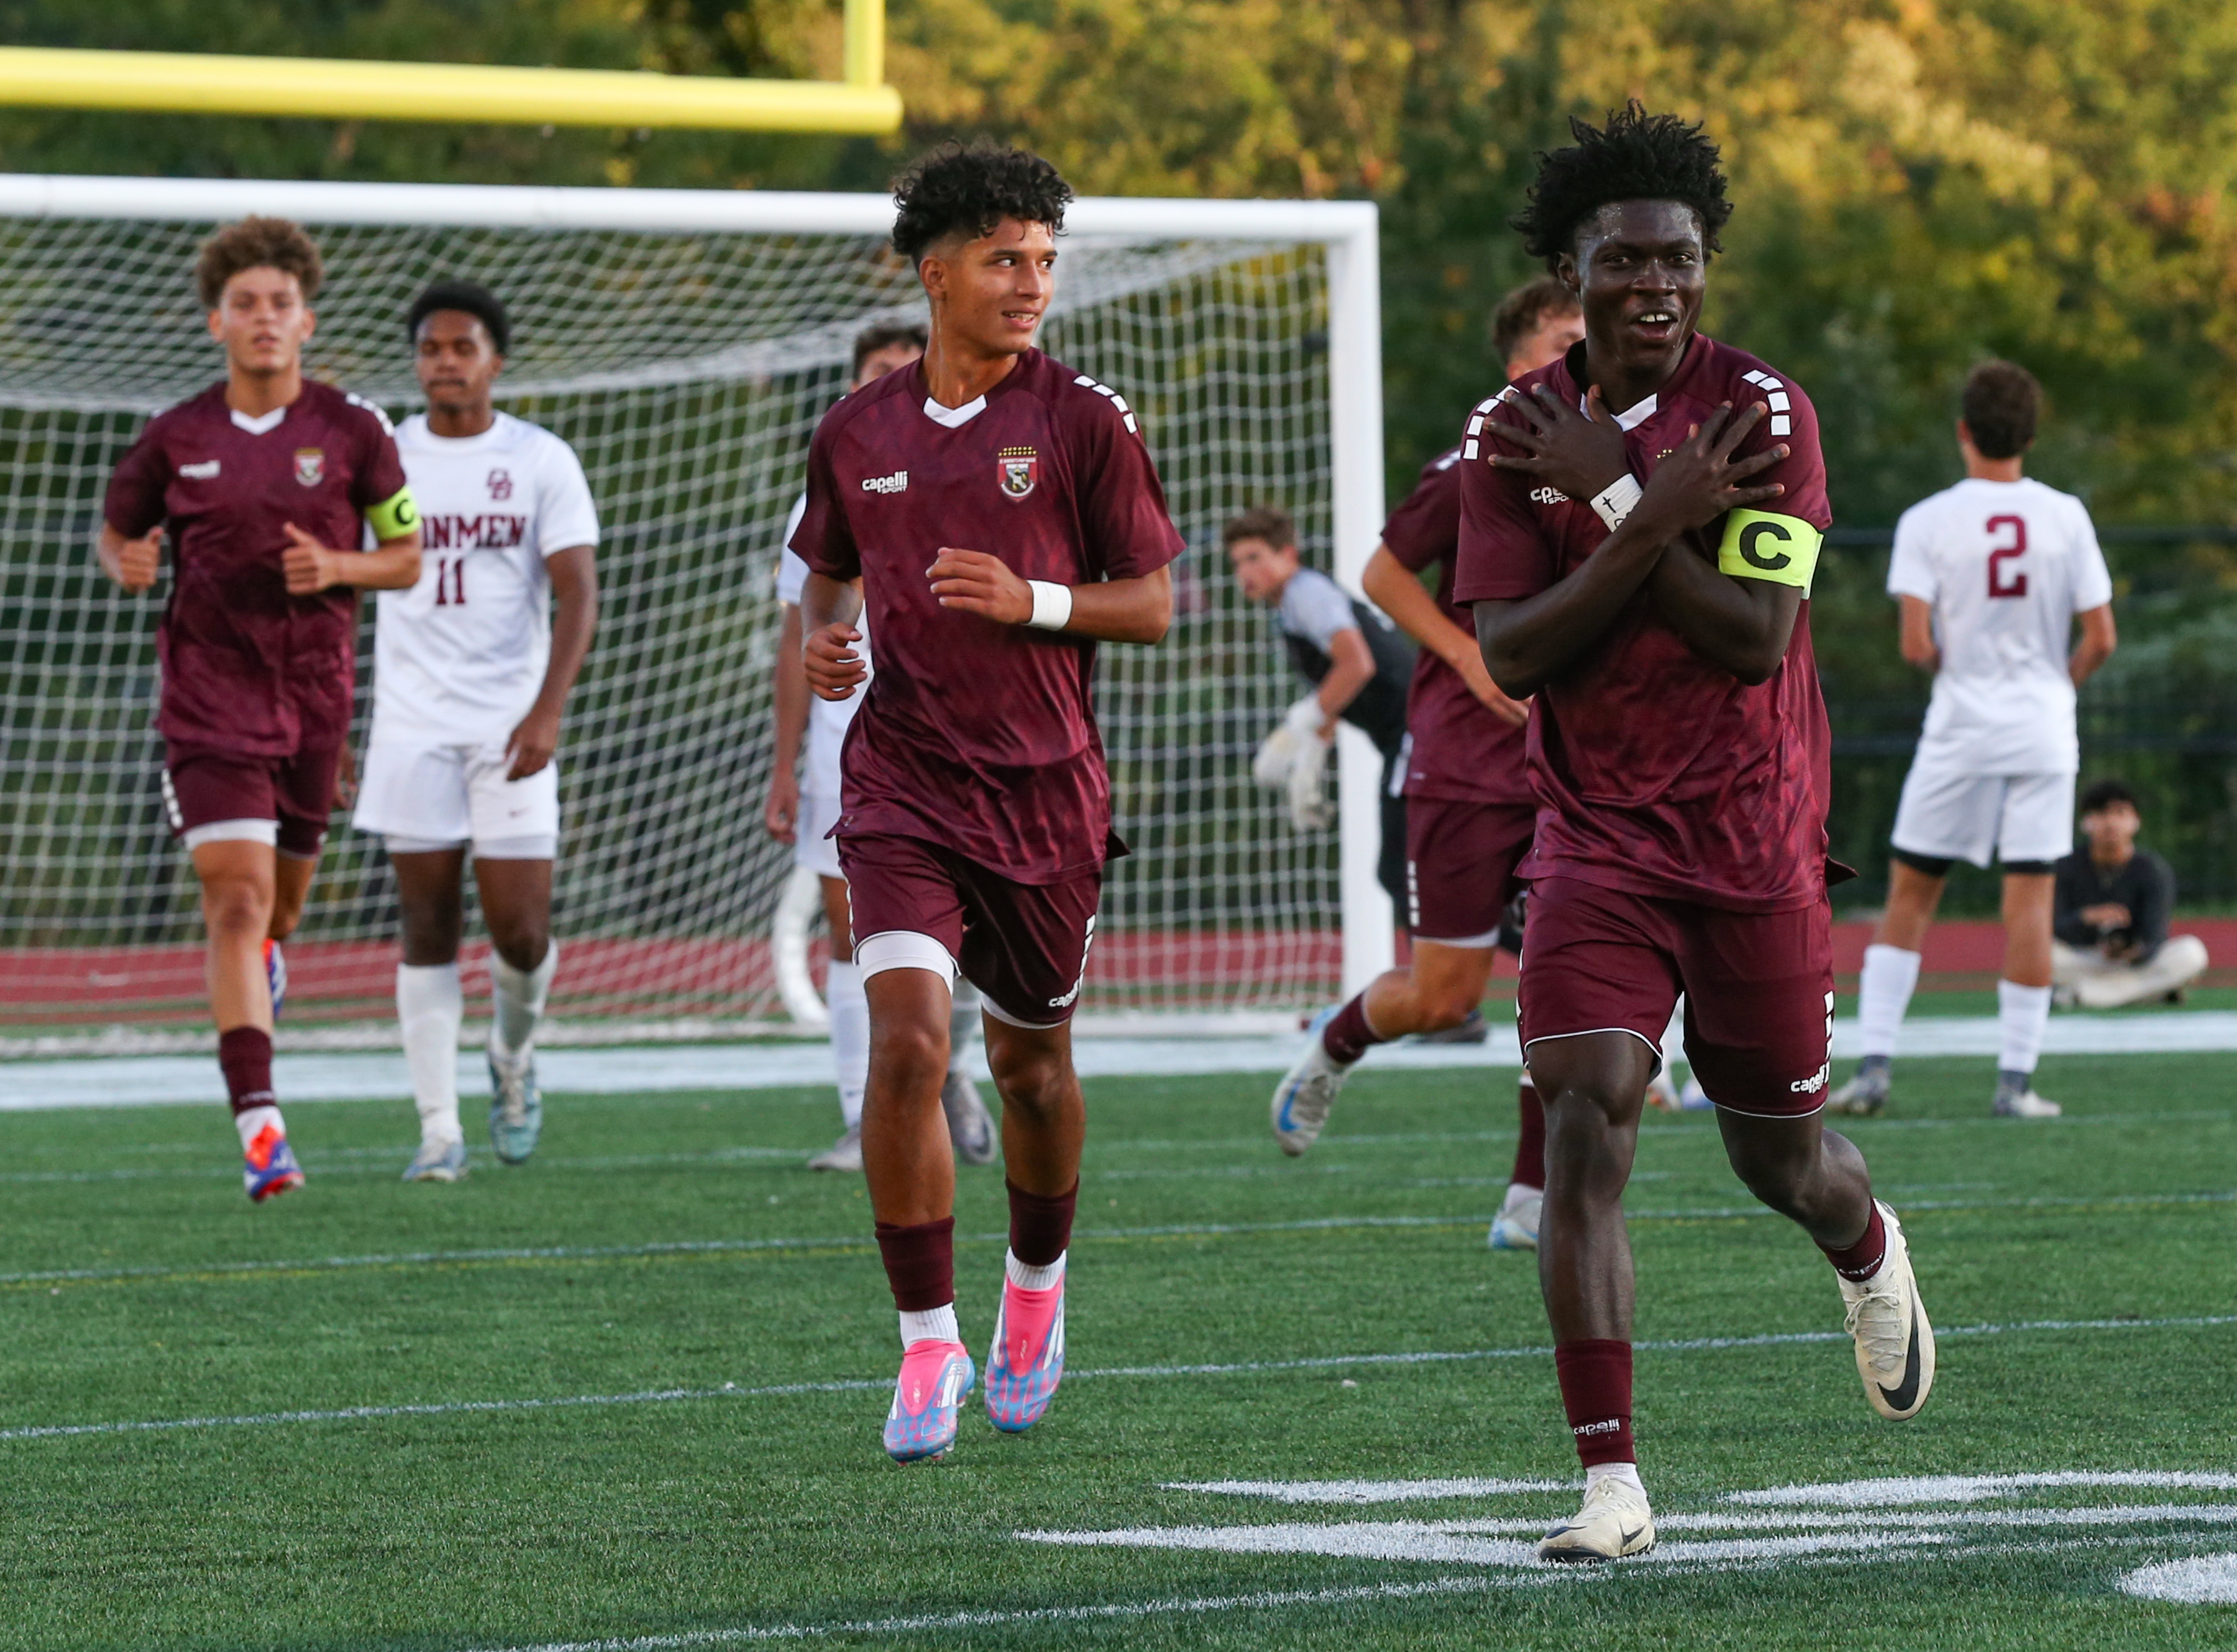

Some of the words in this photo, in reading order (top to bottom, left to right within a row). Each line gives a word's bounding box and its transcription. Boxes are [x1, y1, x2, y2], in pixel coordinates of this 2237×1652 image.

[862, 470, 908, 493] capelli
[395, 500, 414, 524] C
[1739, 521, 1792, 570] C
[1986, 514, 2028, 598] 2
[436, 559, 465, 605] 11
[1573, 1418, 1619, 1436] capelli
